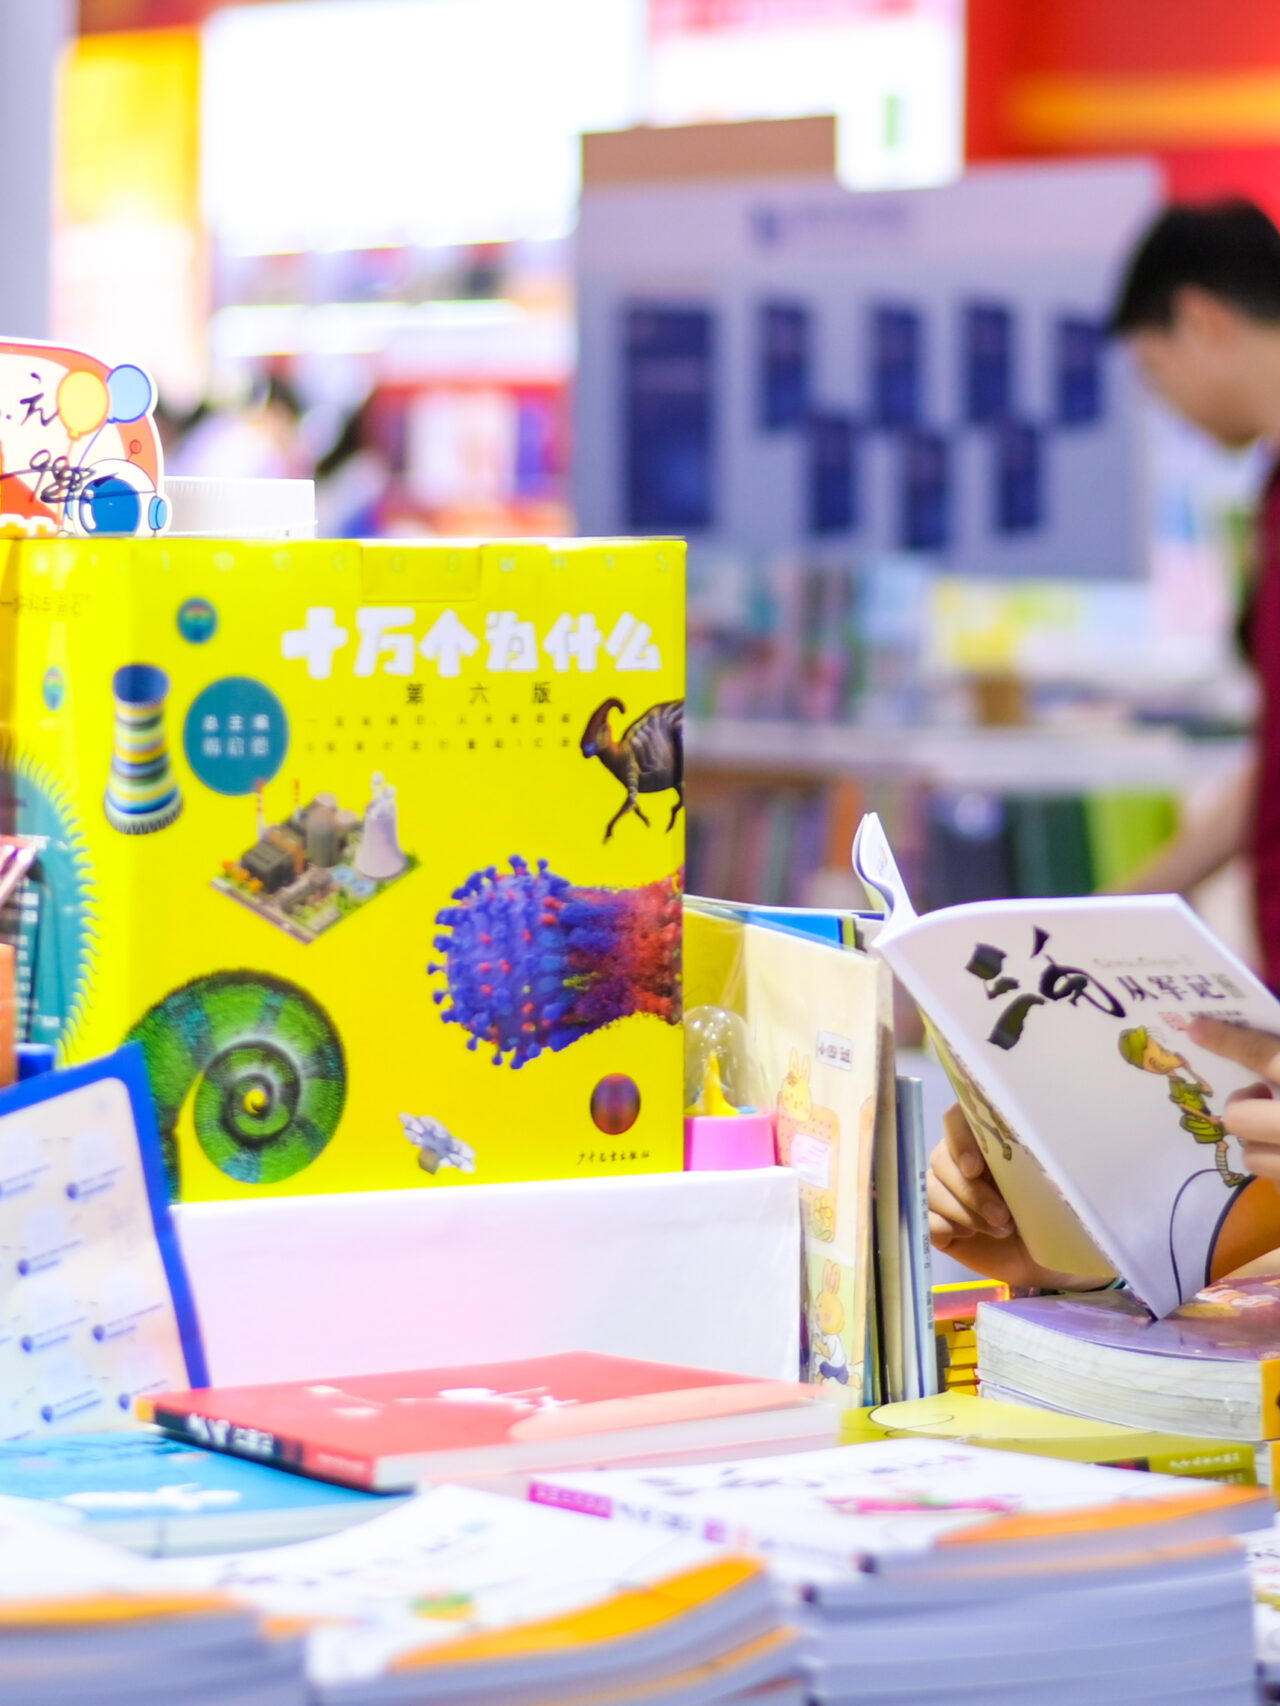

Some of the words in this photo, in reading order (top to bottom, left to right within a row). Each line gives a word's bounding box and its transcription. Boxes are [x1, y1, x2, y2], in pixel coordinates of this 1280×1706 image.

[281, 606, 662, 680] 十万个为什么
[405, 681, 553, 706] 第六版
